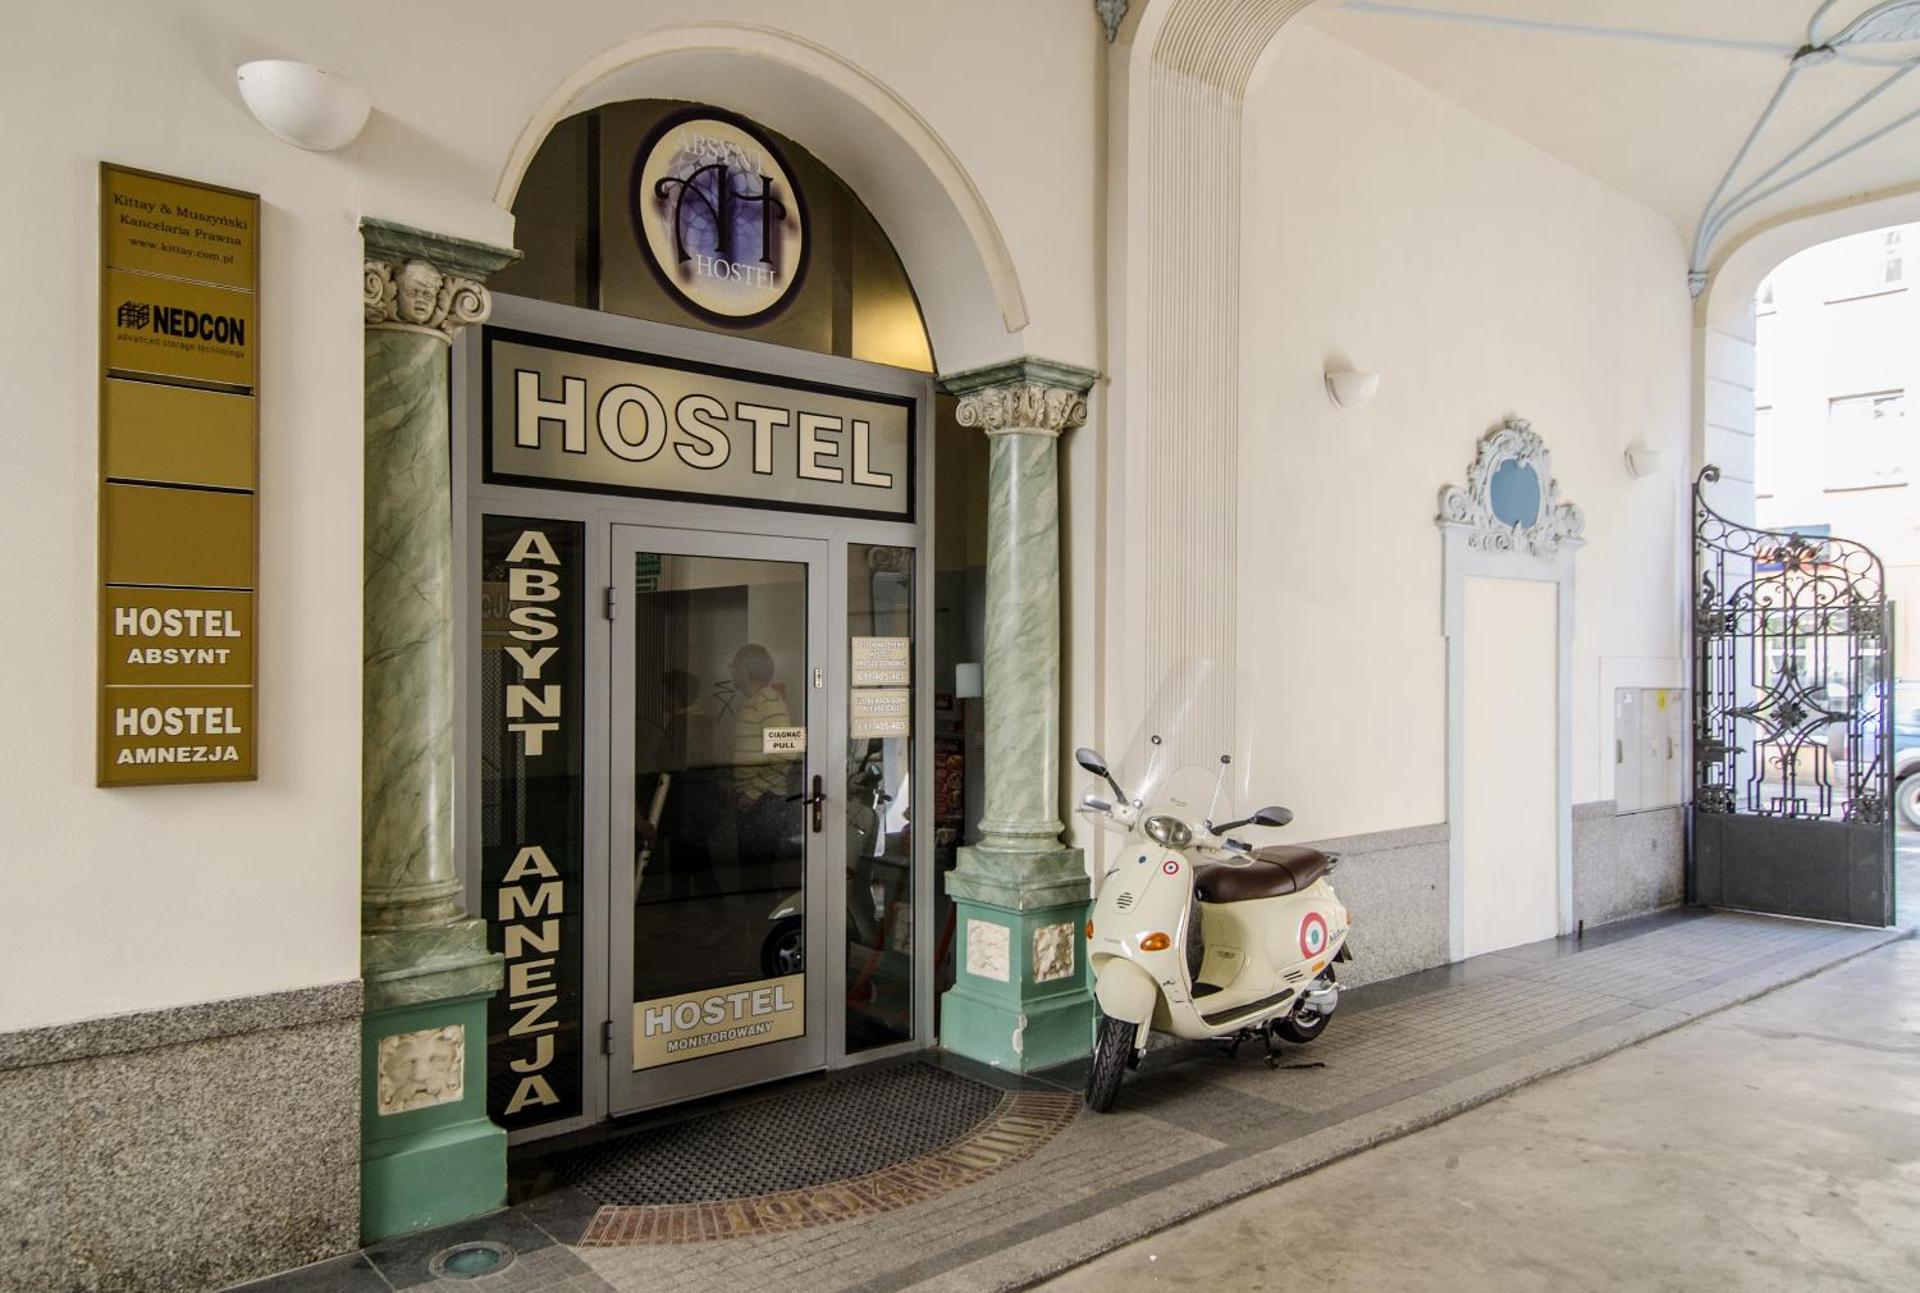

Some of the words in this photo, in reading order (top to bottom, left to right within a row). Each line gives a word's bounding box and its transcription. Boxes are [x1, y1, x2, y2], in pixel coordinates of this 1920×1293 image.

[112, 193, 156, 214] Kittay
[160, 204, 172, 215] &
[177, 205, 248, 230] Muszyński
[120, 214, 190, 237] Kancelaria
[194, 227, 242, 246] Prawna
[697, 254, 781, 292] HOSTEL
[153, 305, 245, 347] NEDCON
[515, 368, 893, 490] HOSTEL
[115, 607, 242, 638] HOSTEL
[127, 648, 231, 665] ABSYNT
[504, 530, 562, 757] ABSYNT
[115, 707, 242, 737] HOSTEL
[116, 745, 240, 764] AMNEZJA
[773, 741, 797, 749] PULL
[498, 845, 563, 1116] AMNEZJA
[644, 984, 795, 1038] HOSTEL
[666, 1020, 775, 1054] MONITOROWANY
